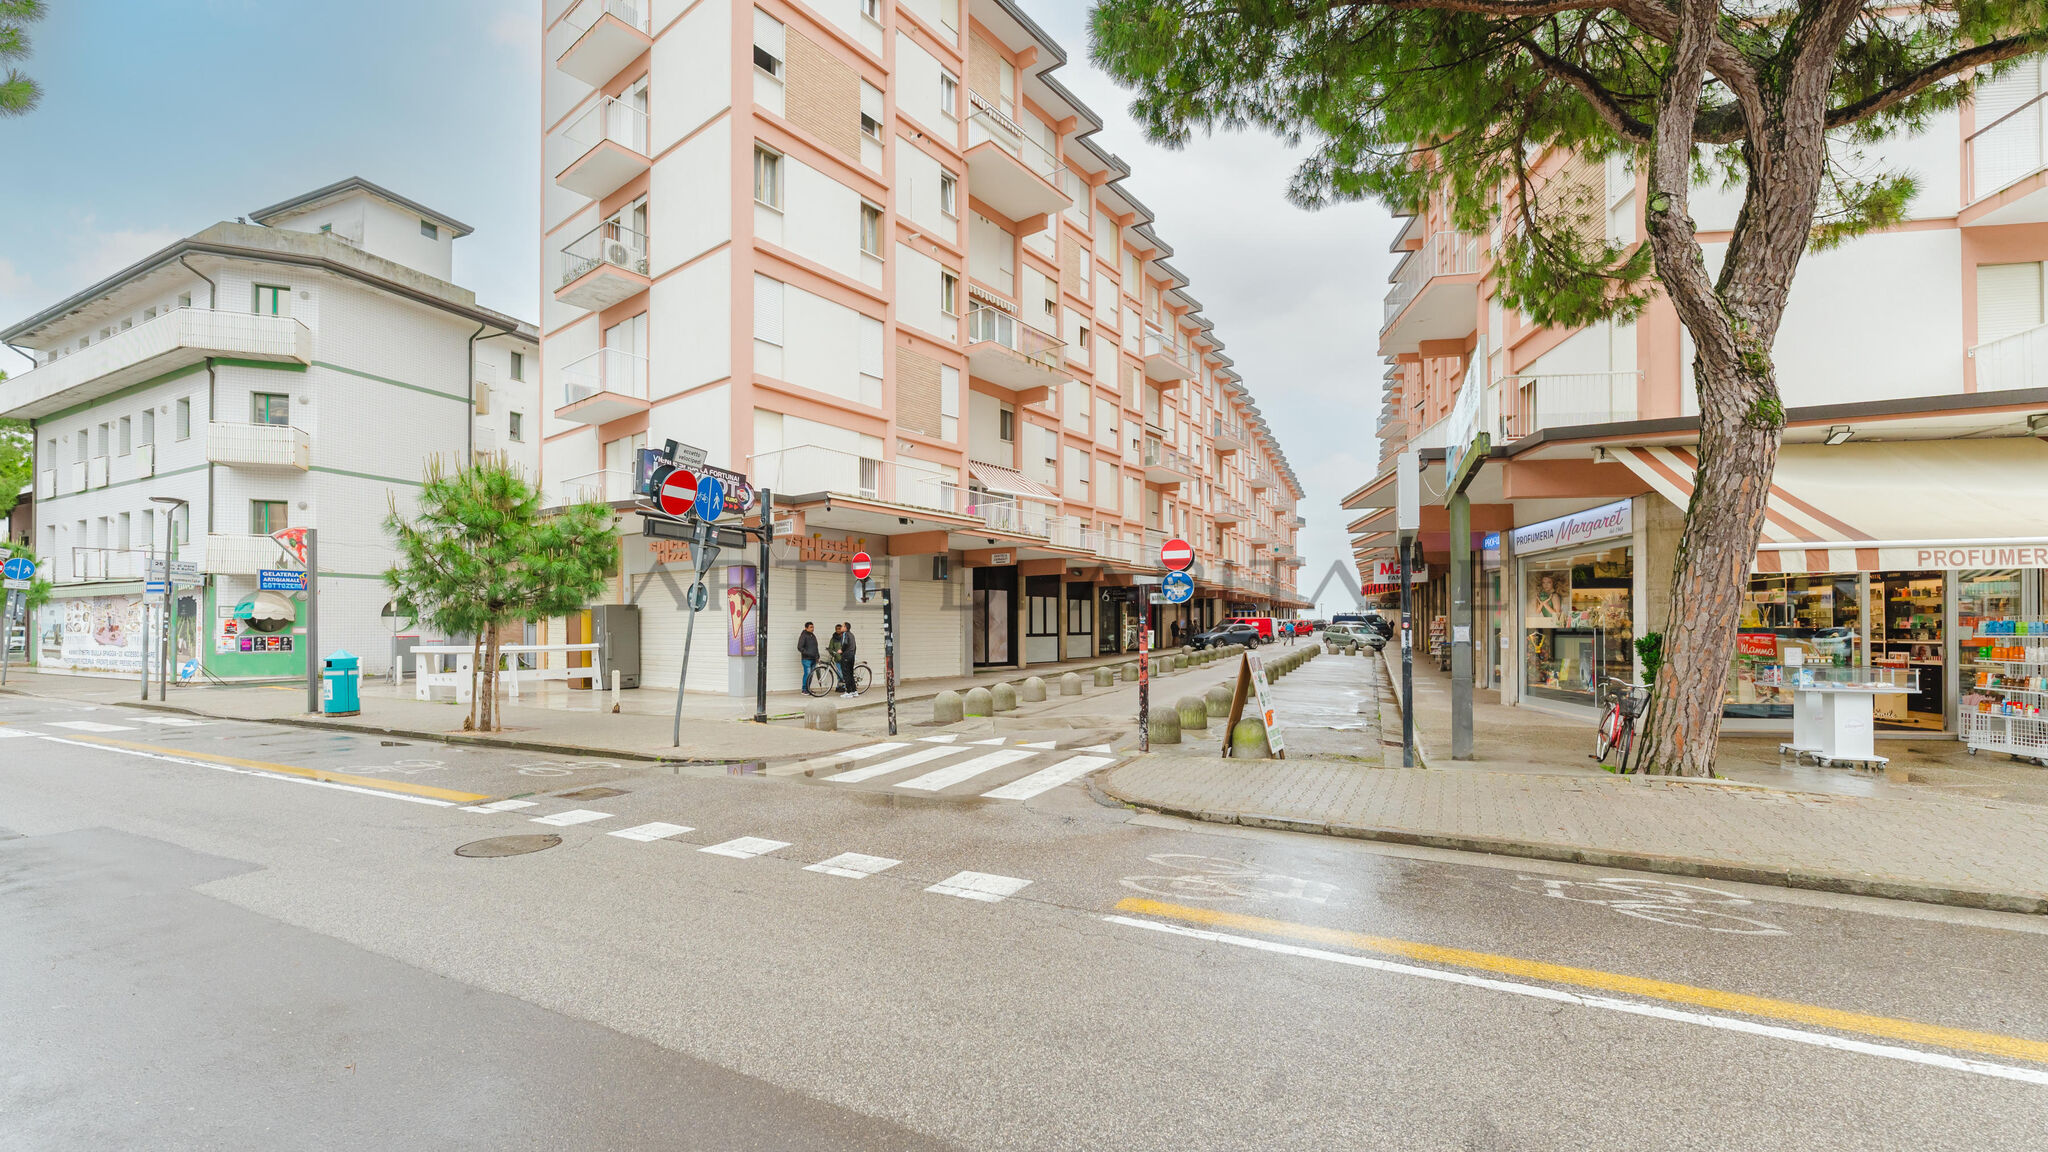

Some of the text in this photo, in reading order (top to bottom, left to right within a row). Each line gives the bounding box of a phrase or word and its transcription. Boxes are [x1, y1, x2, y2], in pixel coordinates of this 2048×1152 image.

[683, 448, 701, 458] eccetto
[709, 468, 740, 481] FORTUNA!
[1516, 506, 1629, 546] PROFUMERIA Margaret
[799, 548, 854, 563] pizza
[1917, 548, 2048, 567] PROFUMER
